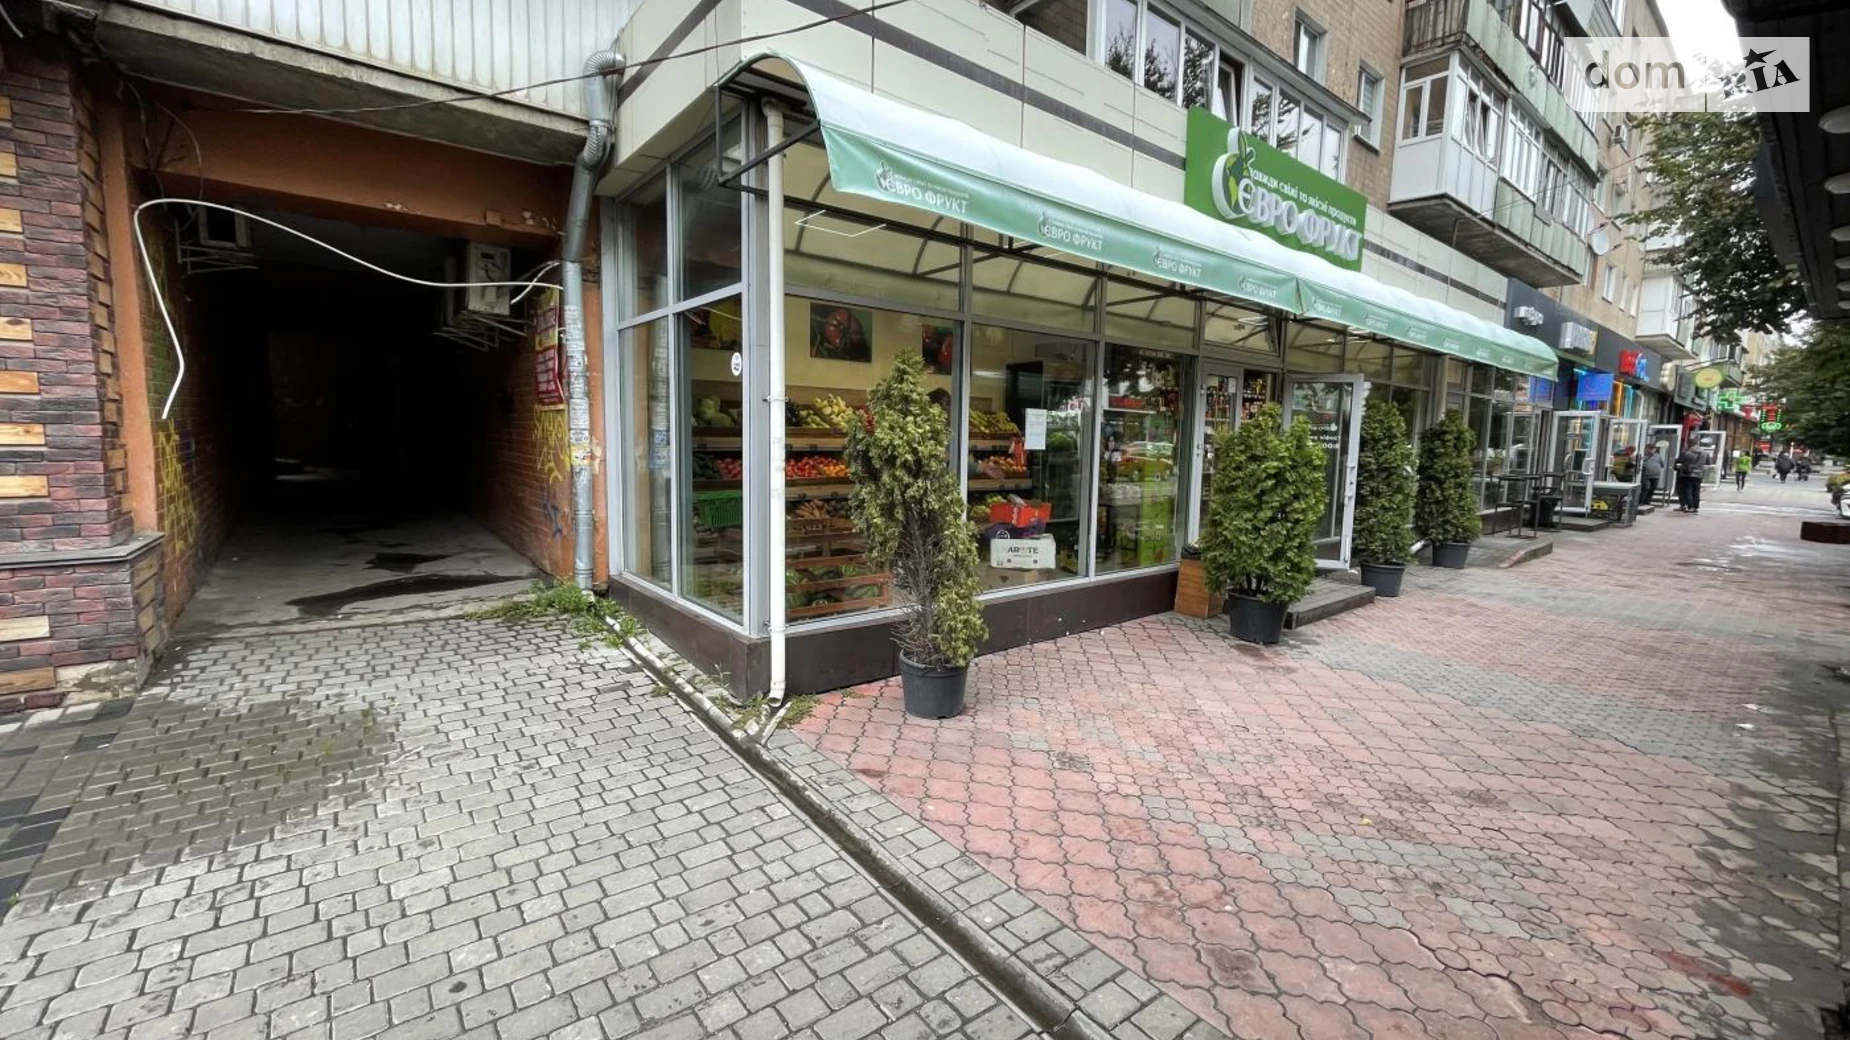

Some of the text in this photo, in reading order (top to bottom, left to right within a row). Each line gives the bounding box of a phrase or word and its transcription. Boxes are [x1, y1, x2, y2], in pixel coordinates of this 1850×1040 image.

[886, 179, 922, 200] ЄВРО
[925, 190, 969, 214] ФРУКТ
[1044, 224, 1071, 243] ЄВРО
[1072, 233, 1103, 251] ФРУКТ
